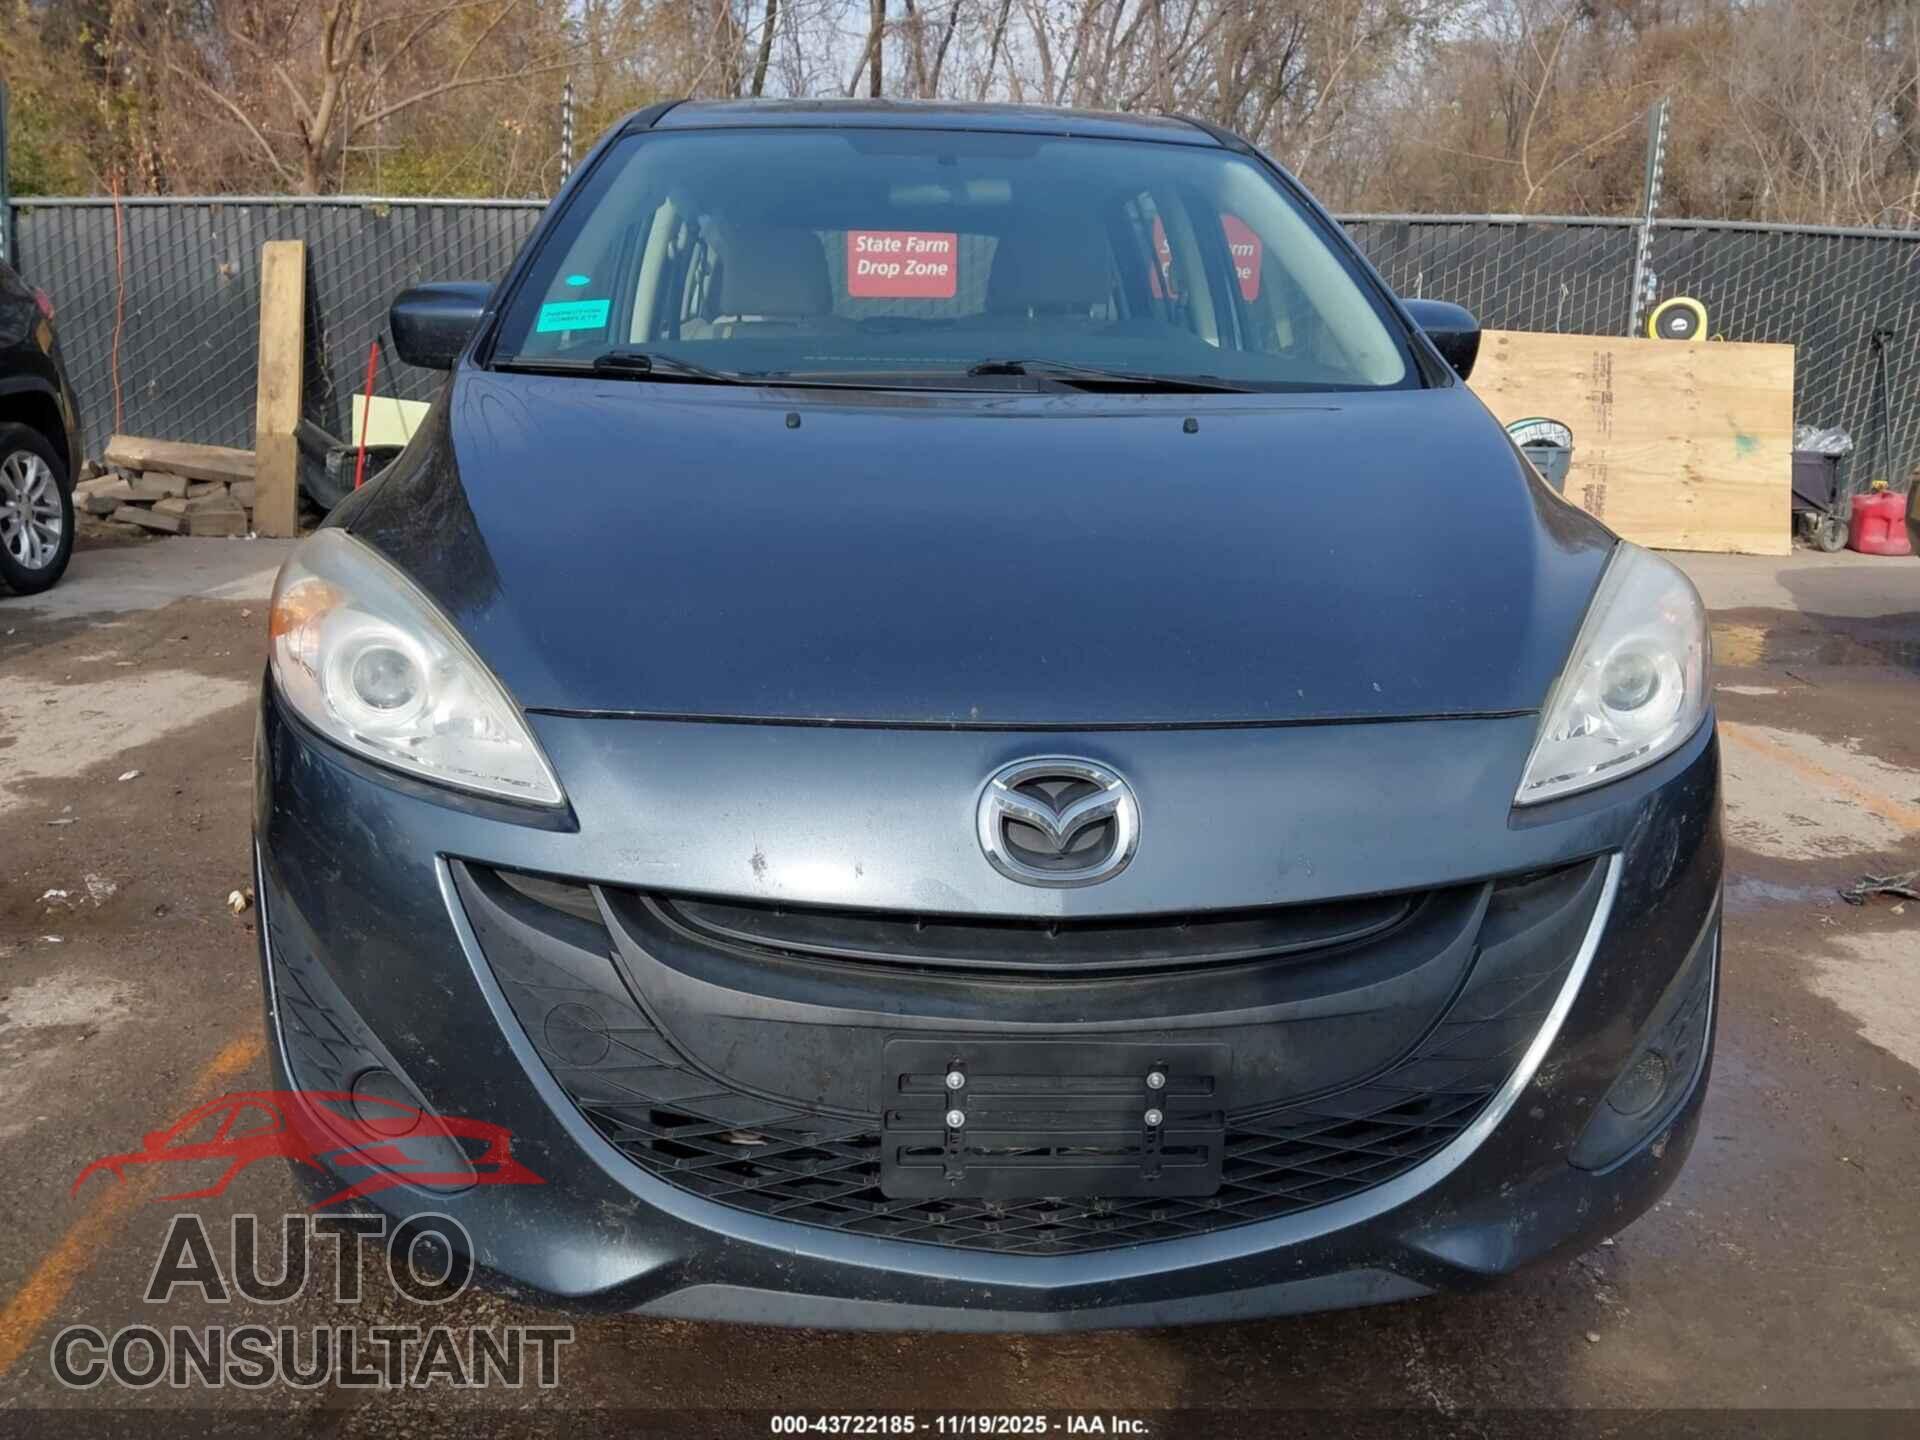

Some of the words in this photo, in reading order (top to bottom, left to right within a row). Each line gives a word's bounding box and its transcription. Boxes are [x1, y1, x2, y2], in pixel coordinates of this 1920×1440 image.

[856, 235, 901, 253] State
[906, 236, 949, 253] Farm
[857, 259, 901, 279] Drop
[904, 260, 949, 276] Zone
